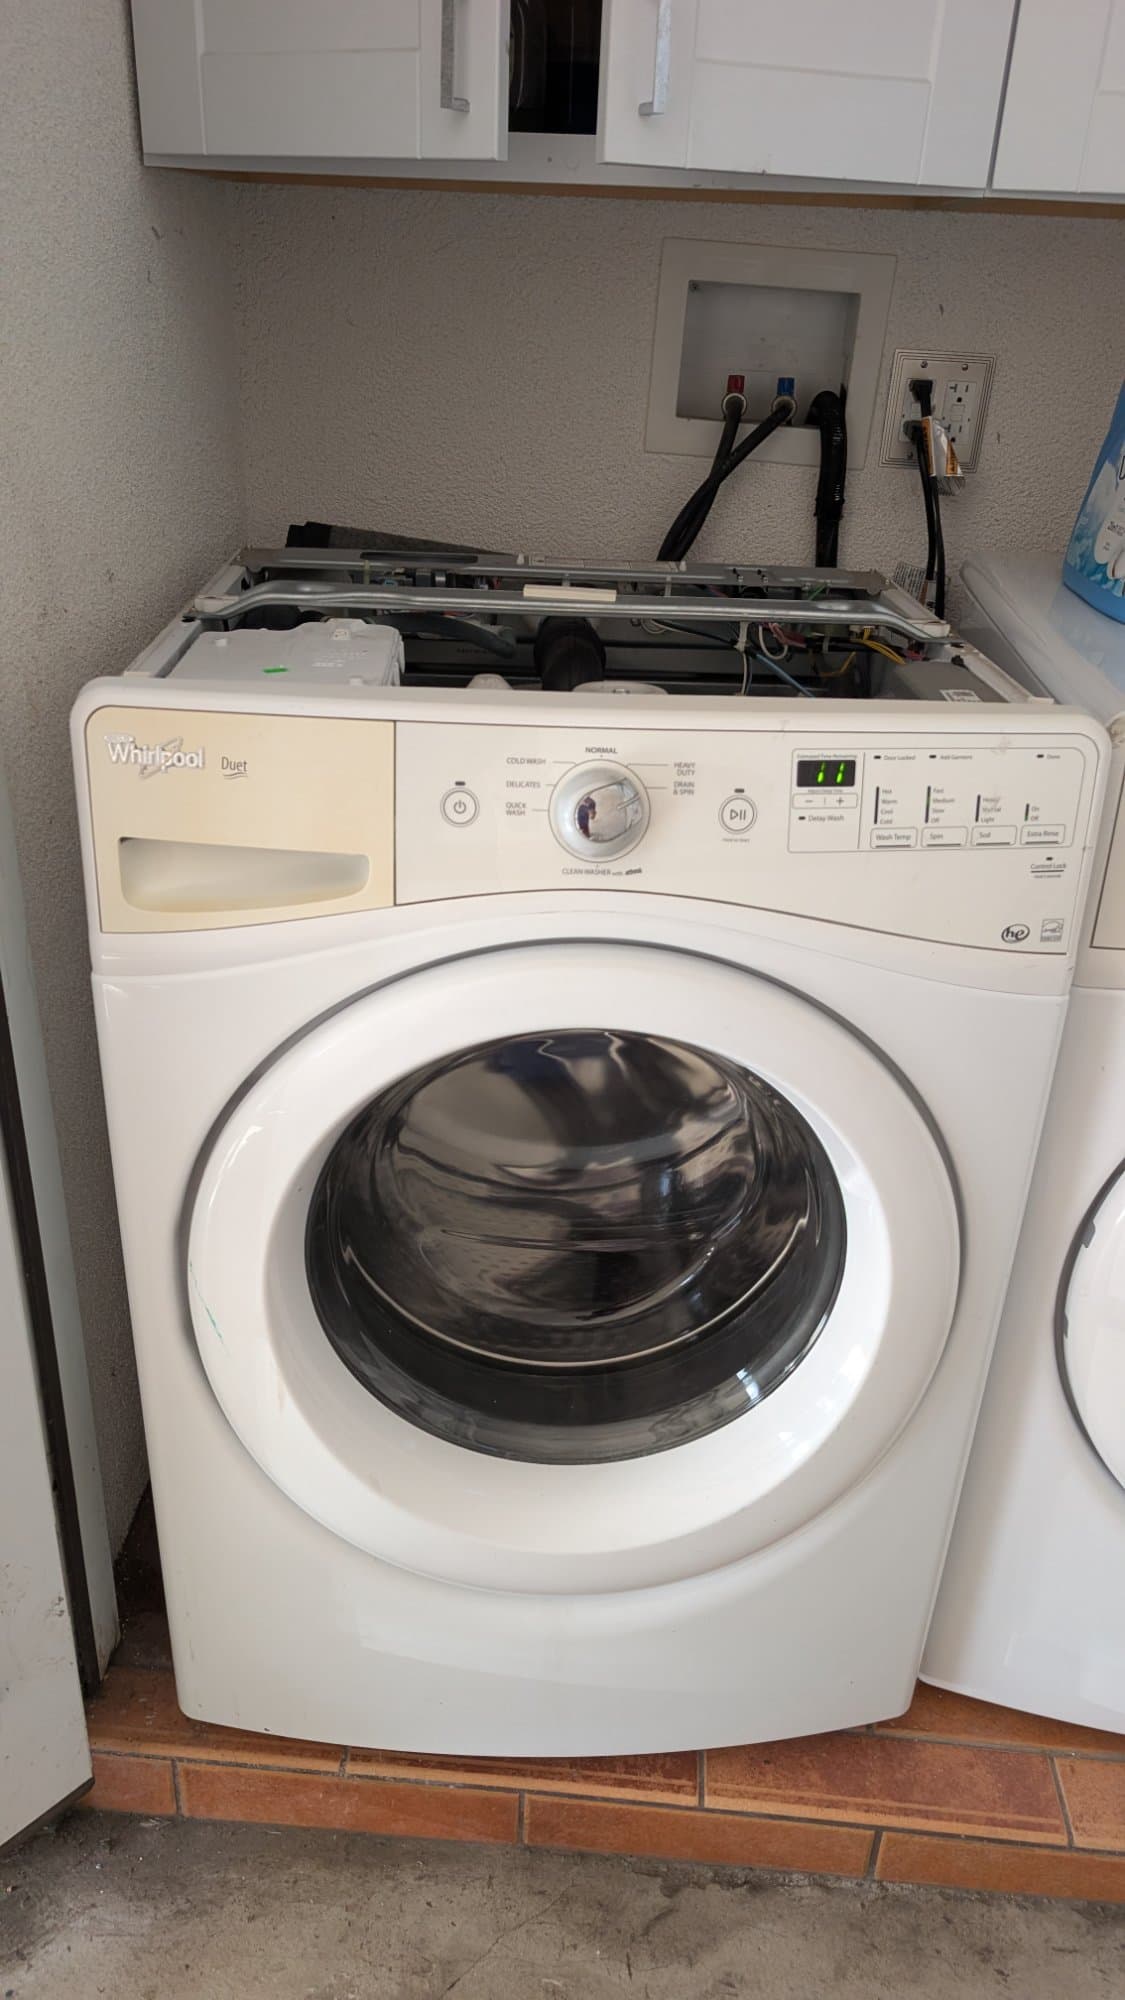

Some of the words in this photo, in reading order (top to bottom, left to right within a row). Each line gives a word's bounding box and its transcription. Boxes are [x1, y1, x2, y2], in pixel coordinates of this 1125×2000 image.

[107, 742, 204, 773] Whirlpool
[221, 756, 248, 772] Duet
[506, 781, 541, 789] DELICATES
[1006, 929, 1026, 942] he
